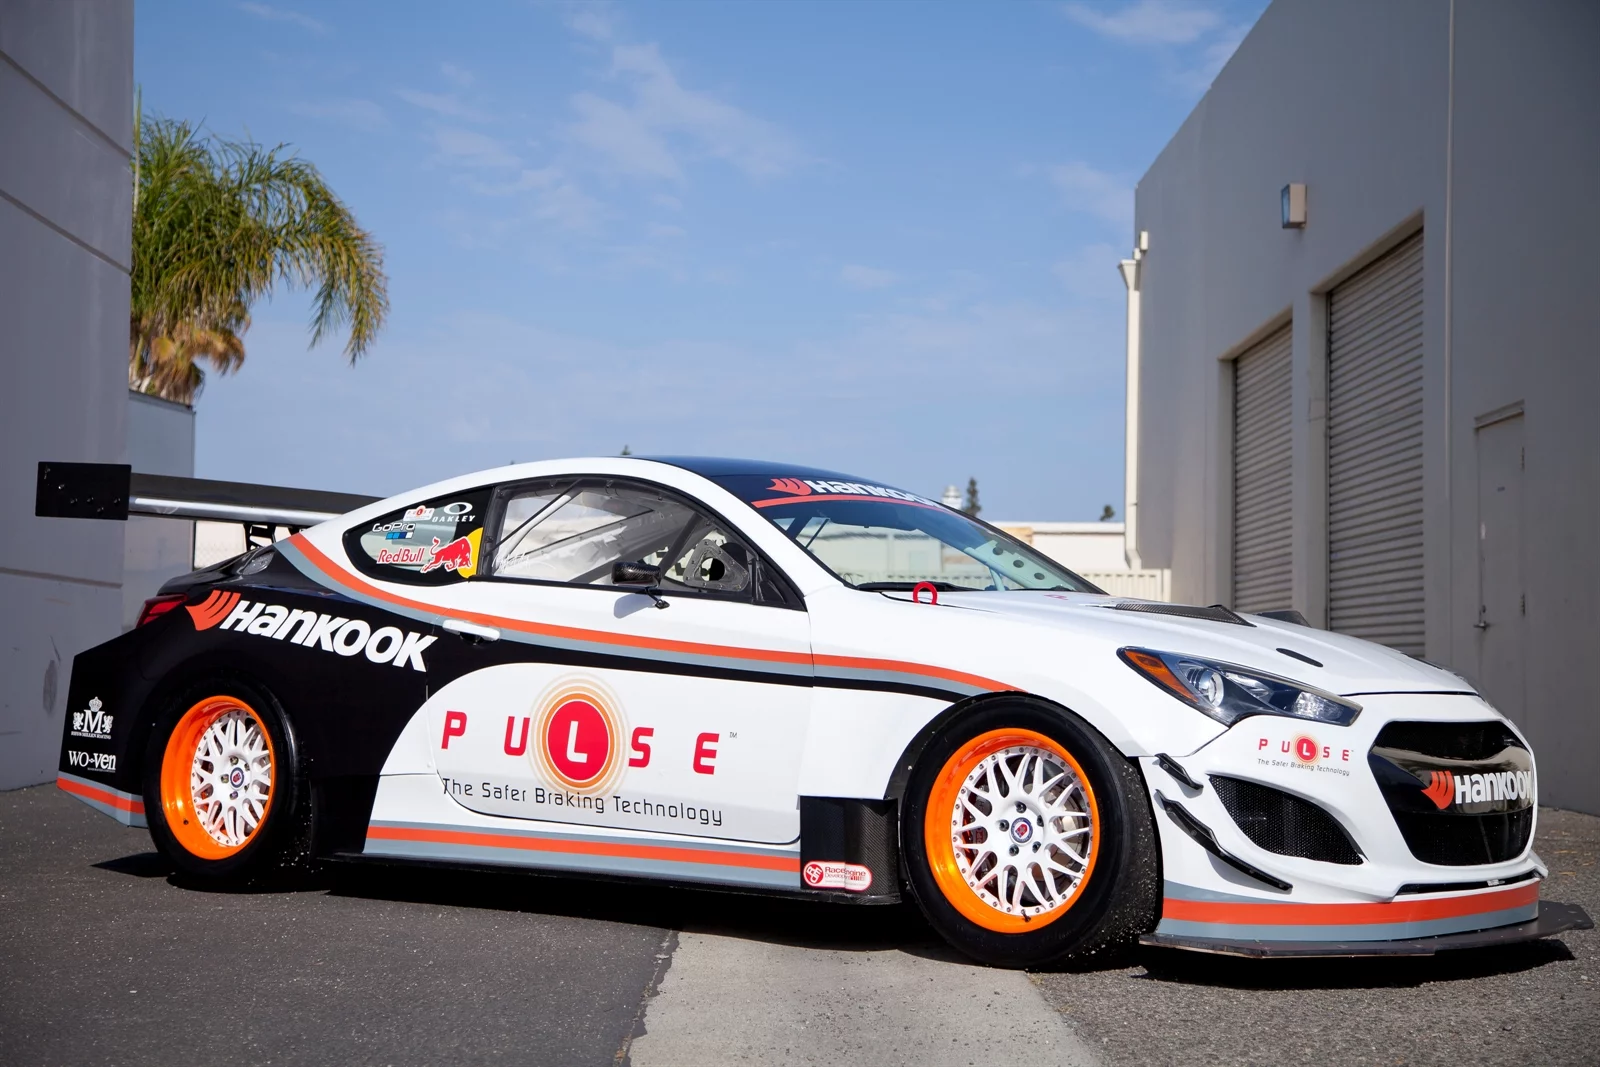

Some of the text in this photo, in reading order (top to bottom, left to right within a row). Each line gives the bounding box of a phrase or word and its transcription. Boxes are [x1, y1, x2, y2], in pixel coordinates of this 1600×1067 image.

[372, 522, 416, 532] GoPro
[431, 515, 476, 523] OAKLEY
[377, 547, 425, 563] Red Bull
[1272, 759, 1289, 767] Safer
[1290, 761, 1315, 771] Braking
[1316, 765, 1350, 776] Technology
[442, 778, 723, 826] The Safer Braking Technology
